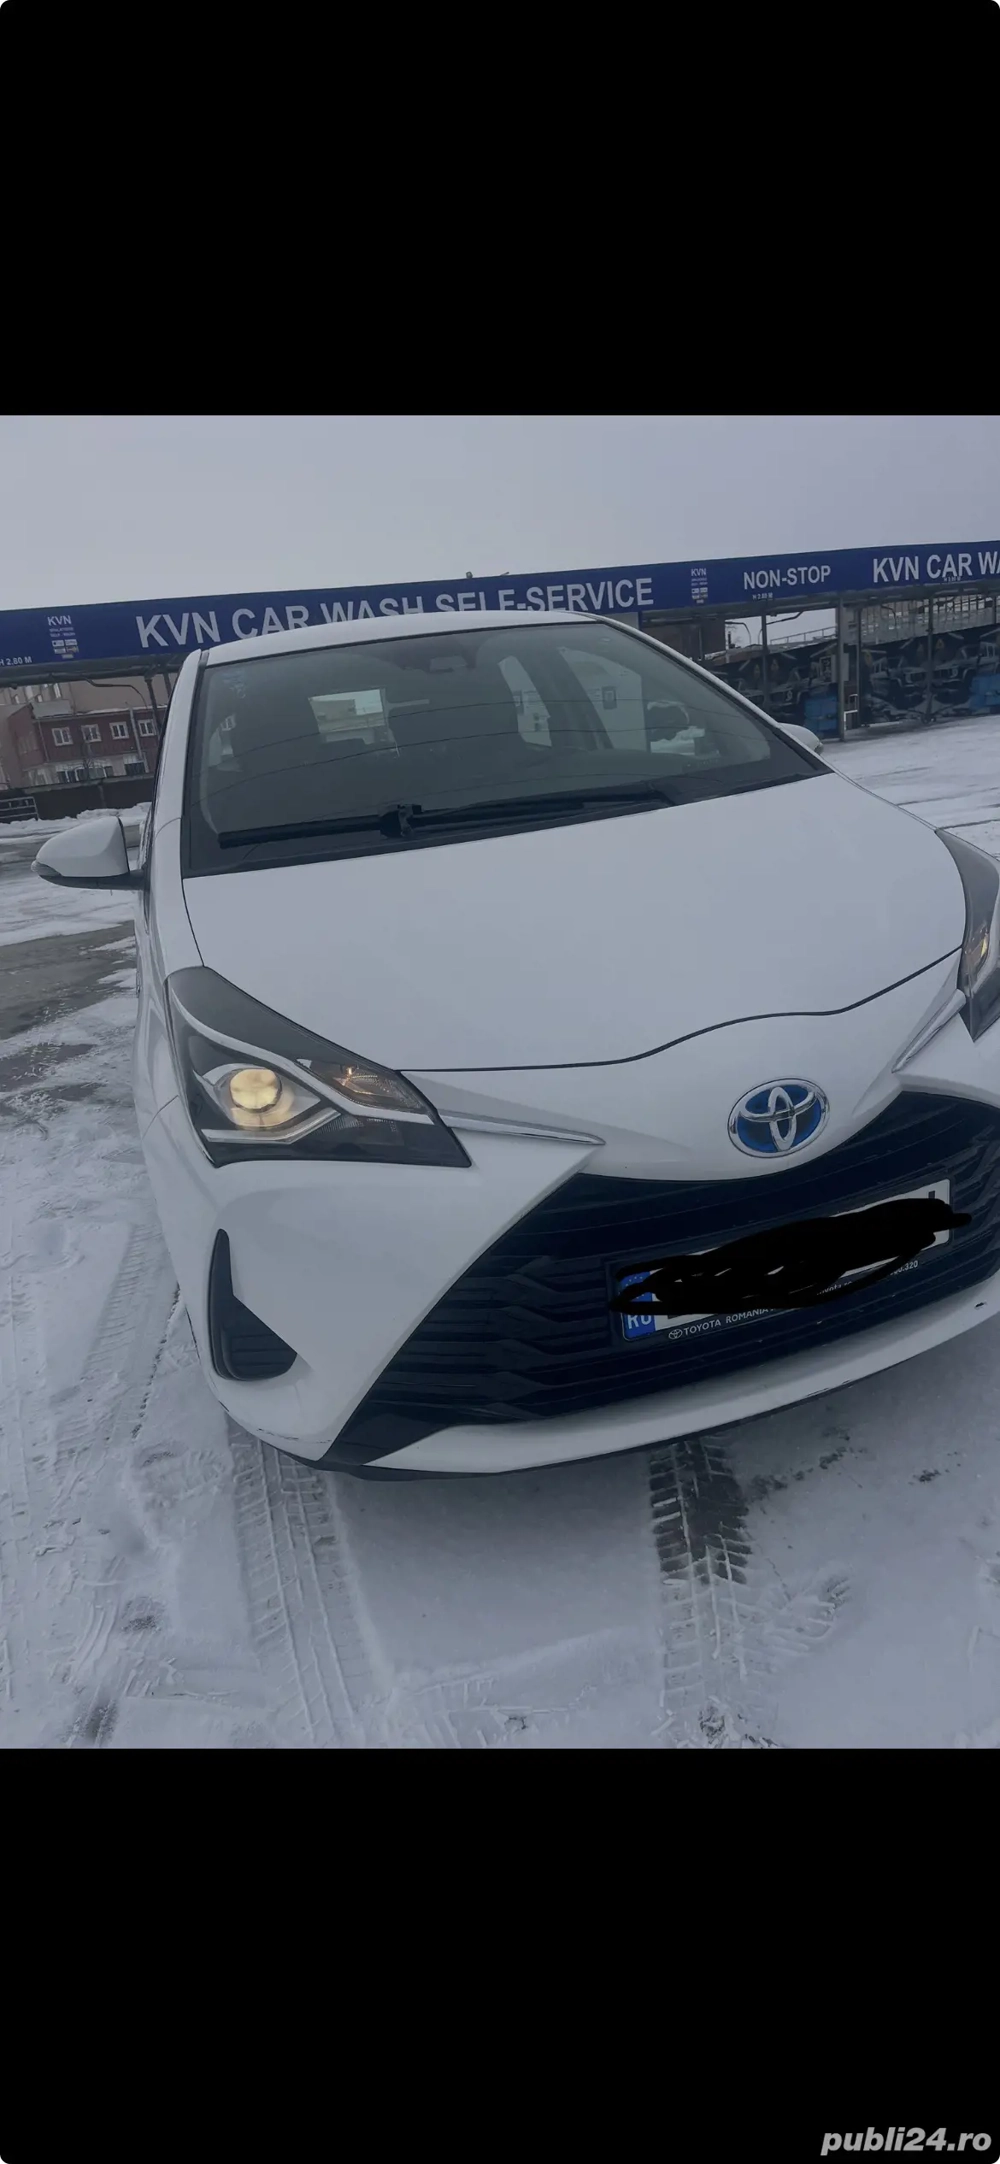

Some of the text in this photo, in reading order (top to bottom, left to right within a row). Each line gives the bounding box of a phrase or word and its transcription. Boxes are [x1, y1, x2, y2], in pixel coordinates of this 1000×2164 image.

[690, 568, 707, 577] KVN
[743, 565, 831, 590] NON-STOP
[873, 551, 1000, 583] KVN CAR W
[47, 615, 72, 626] KVN
[136, 611, 221, 648] KVN
[231, 605, 309, 640] CAR
[320, 596, 424, 624] WASH
[6, 656, 23, 666] 2.80
[24, 656, 33, 664] M
[684, 1308, 769, 1336] TOYOTA ROMANIA
